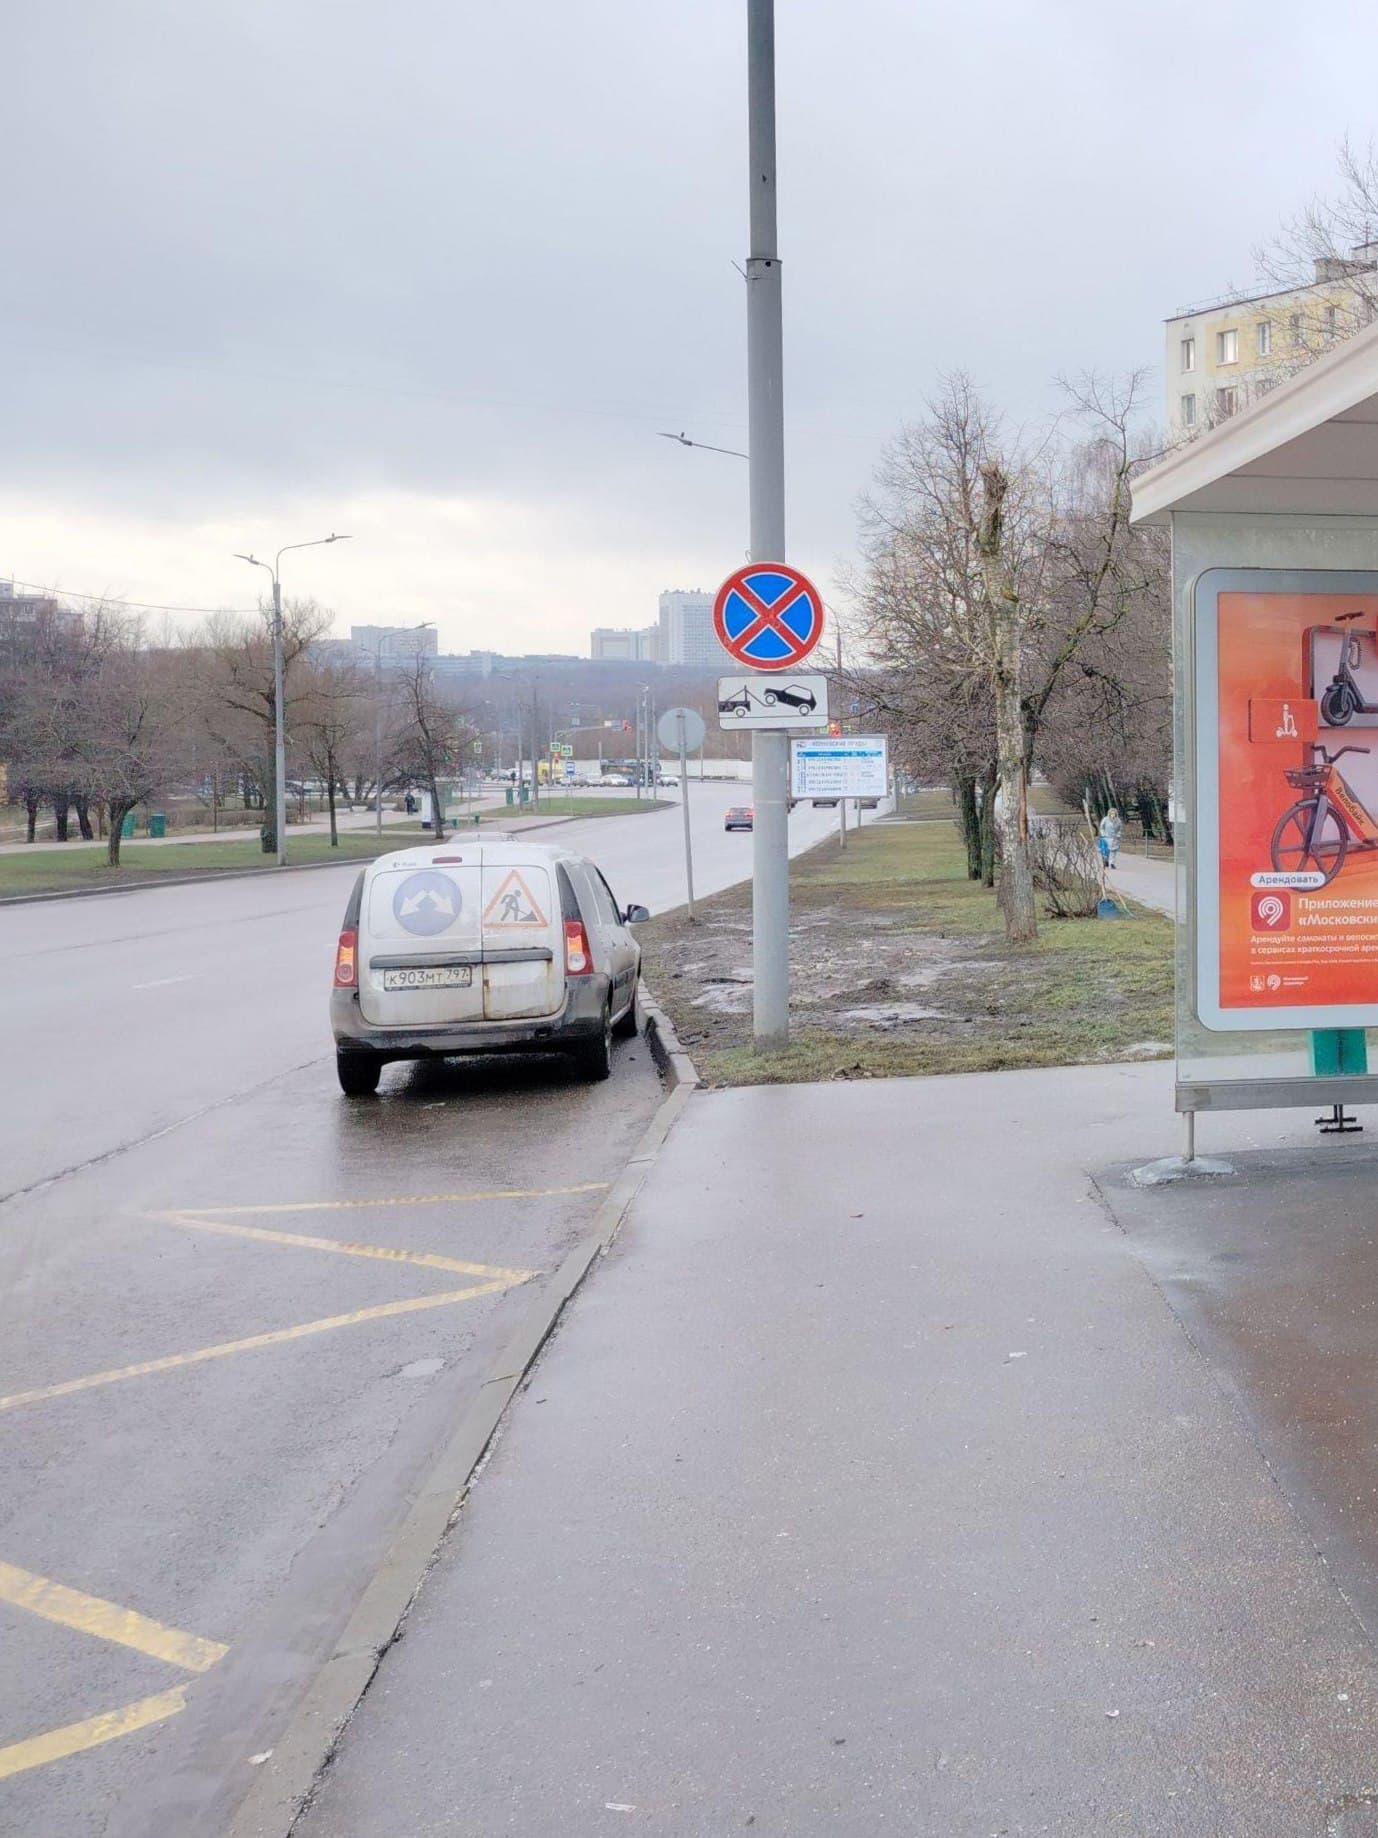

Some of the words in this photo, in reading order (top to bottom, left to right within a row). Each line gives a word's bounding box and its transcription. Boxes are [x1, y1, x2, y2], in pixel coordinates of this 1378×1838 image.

[1258, 875, 1319, 886] Арендовать
[1250, 935, 1295, 945] Арендуйте
[1297, 934, 1337, 942] самокаты
[1258, 947, 1296, 956] сервисах
[1297, 944, 1360, 955] краткосрочной
[389, 970, 444, 985] К903МТ
[446, 968, 468, 979] 797
